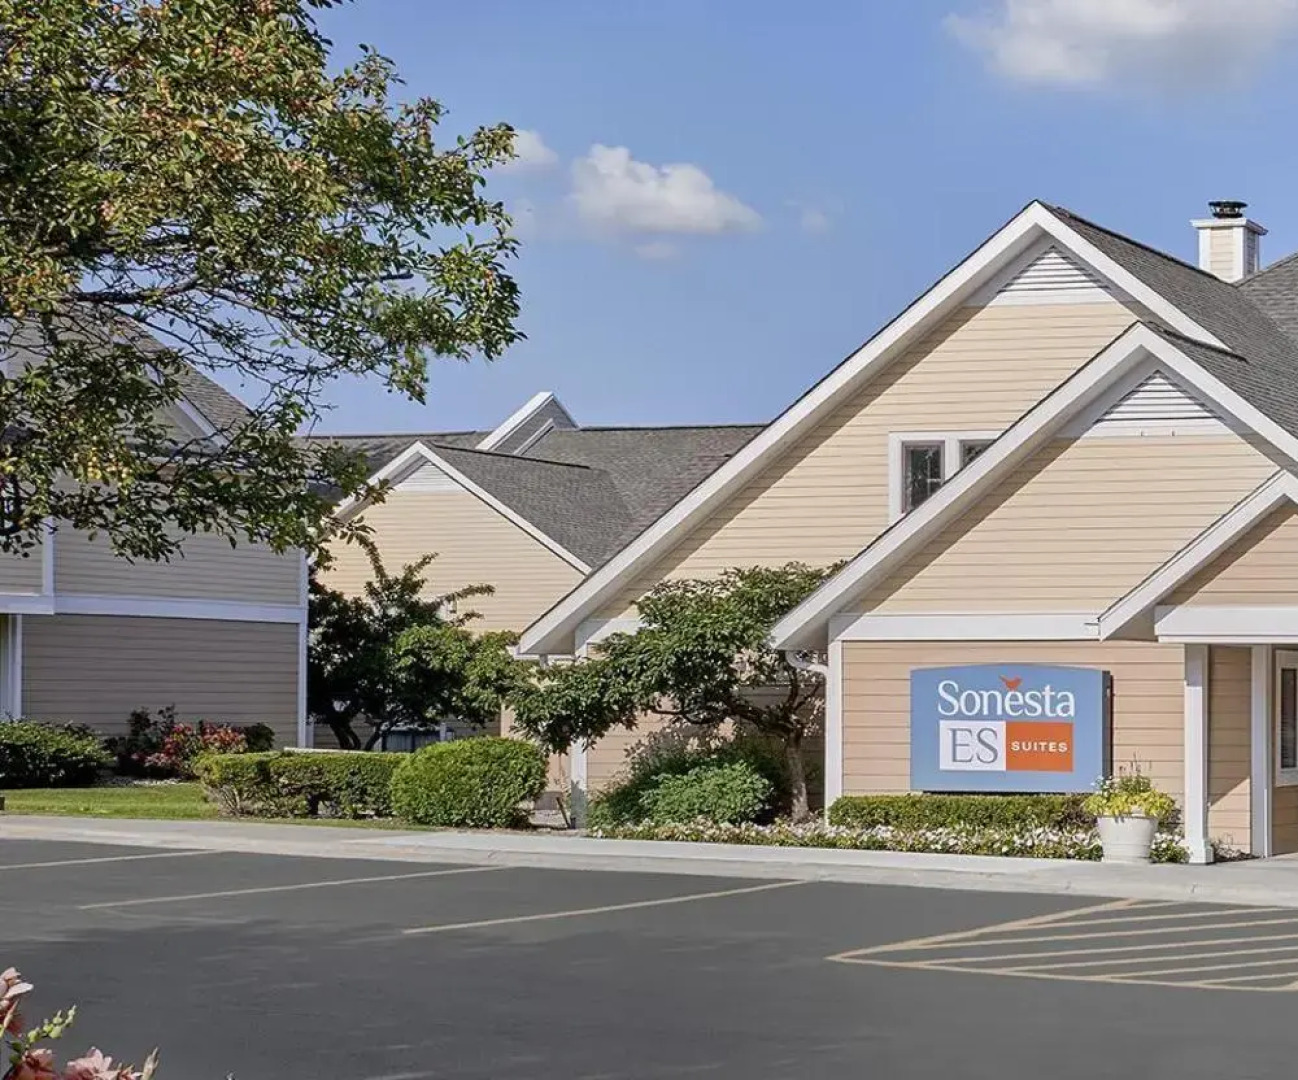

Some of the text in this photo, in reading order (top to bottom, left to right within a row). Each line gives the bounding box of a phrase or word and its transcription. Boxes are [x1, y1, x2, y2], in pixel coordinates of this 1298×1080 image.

[938, 680, 1075, 717] Sonesta
[949, 727, 1067, 764] ES SUITES
